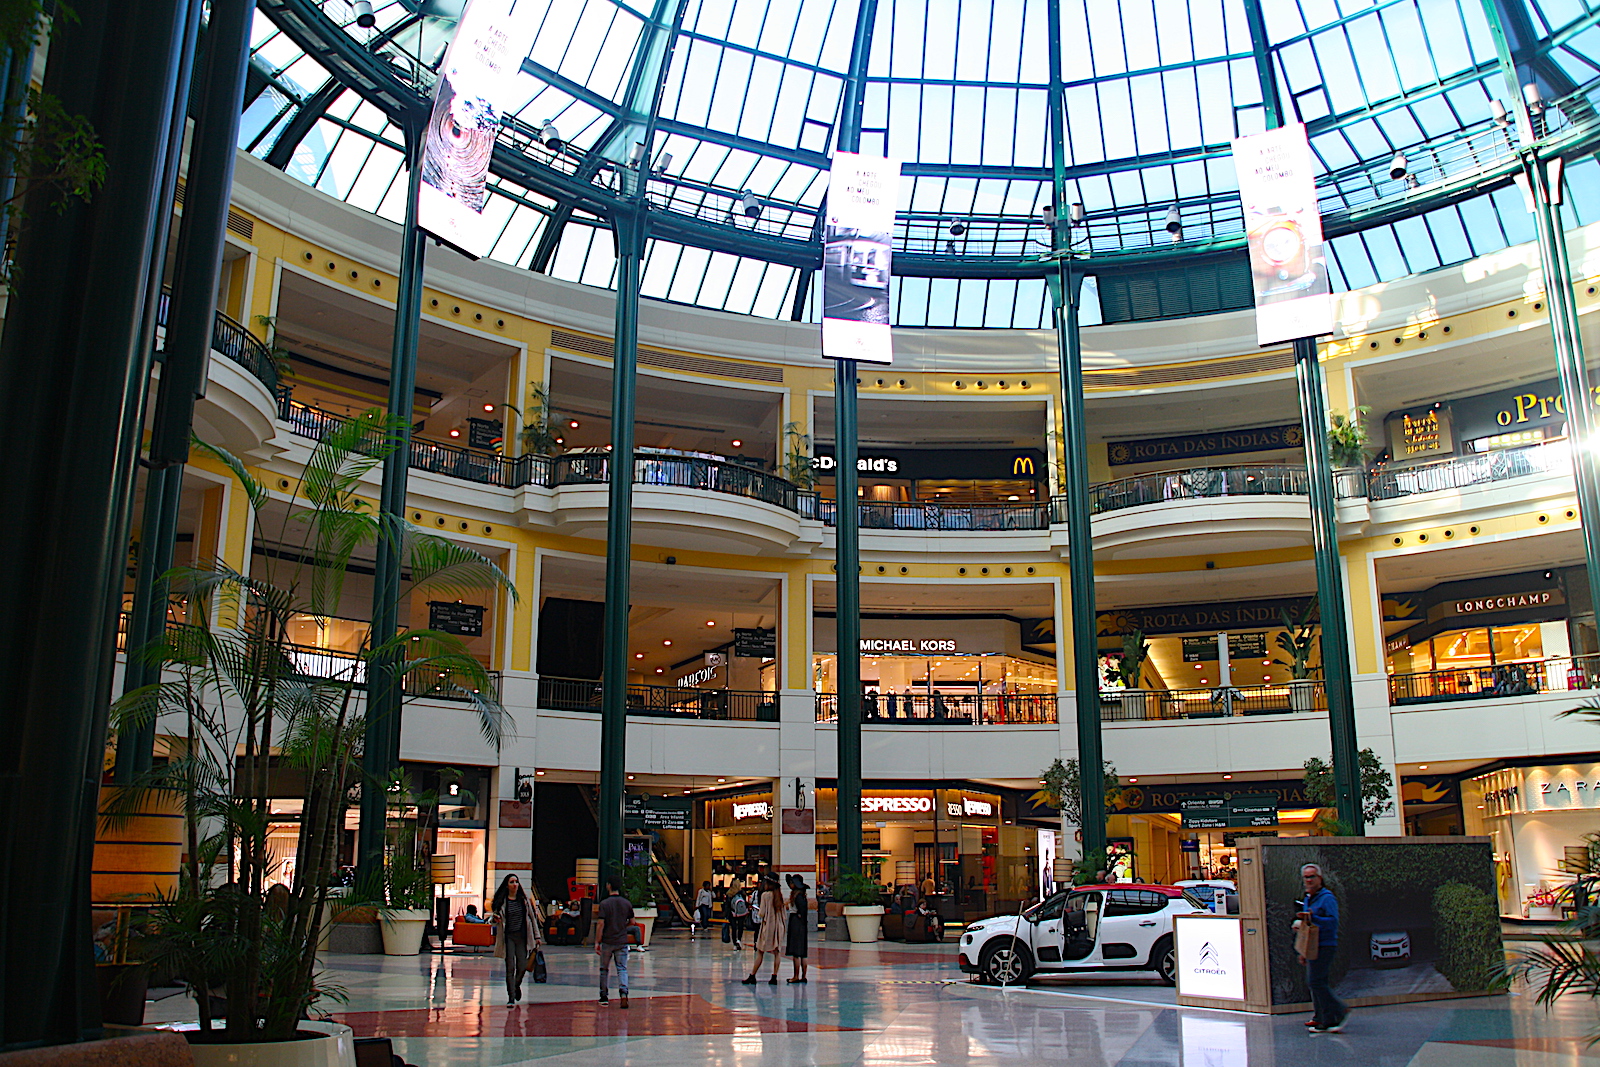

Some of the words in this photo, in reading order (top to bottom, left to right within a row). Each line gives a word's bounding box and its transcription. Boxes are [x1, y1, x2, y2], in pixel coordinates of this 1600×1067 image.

[1134, 442, 1179, 458] ROTA
[1183, 437, 1217, 453] DAS
[1221, 431, 1280, 449] ÍNDIAS
[1456, 593, 1550, 613] LONGCHAMP
[1143, 612, 1190, 629] ROTA
[1196, 609, 1231, 625] DAS
[860, 640, 917, 651] MICHAEL
[920, 640, 956, 651] KORS
[1540, 780, 1600, 794] ZARA
[861, 797, 931, 812] ESPRESSO
[1193, 967, 1227, 976] CITROËN
